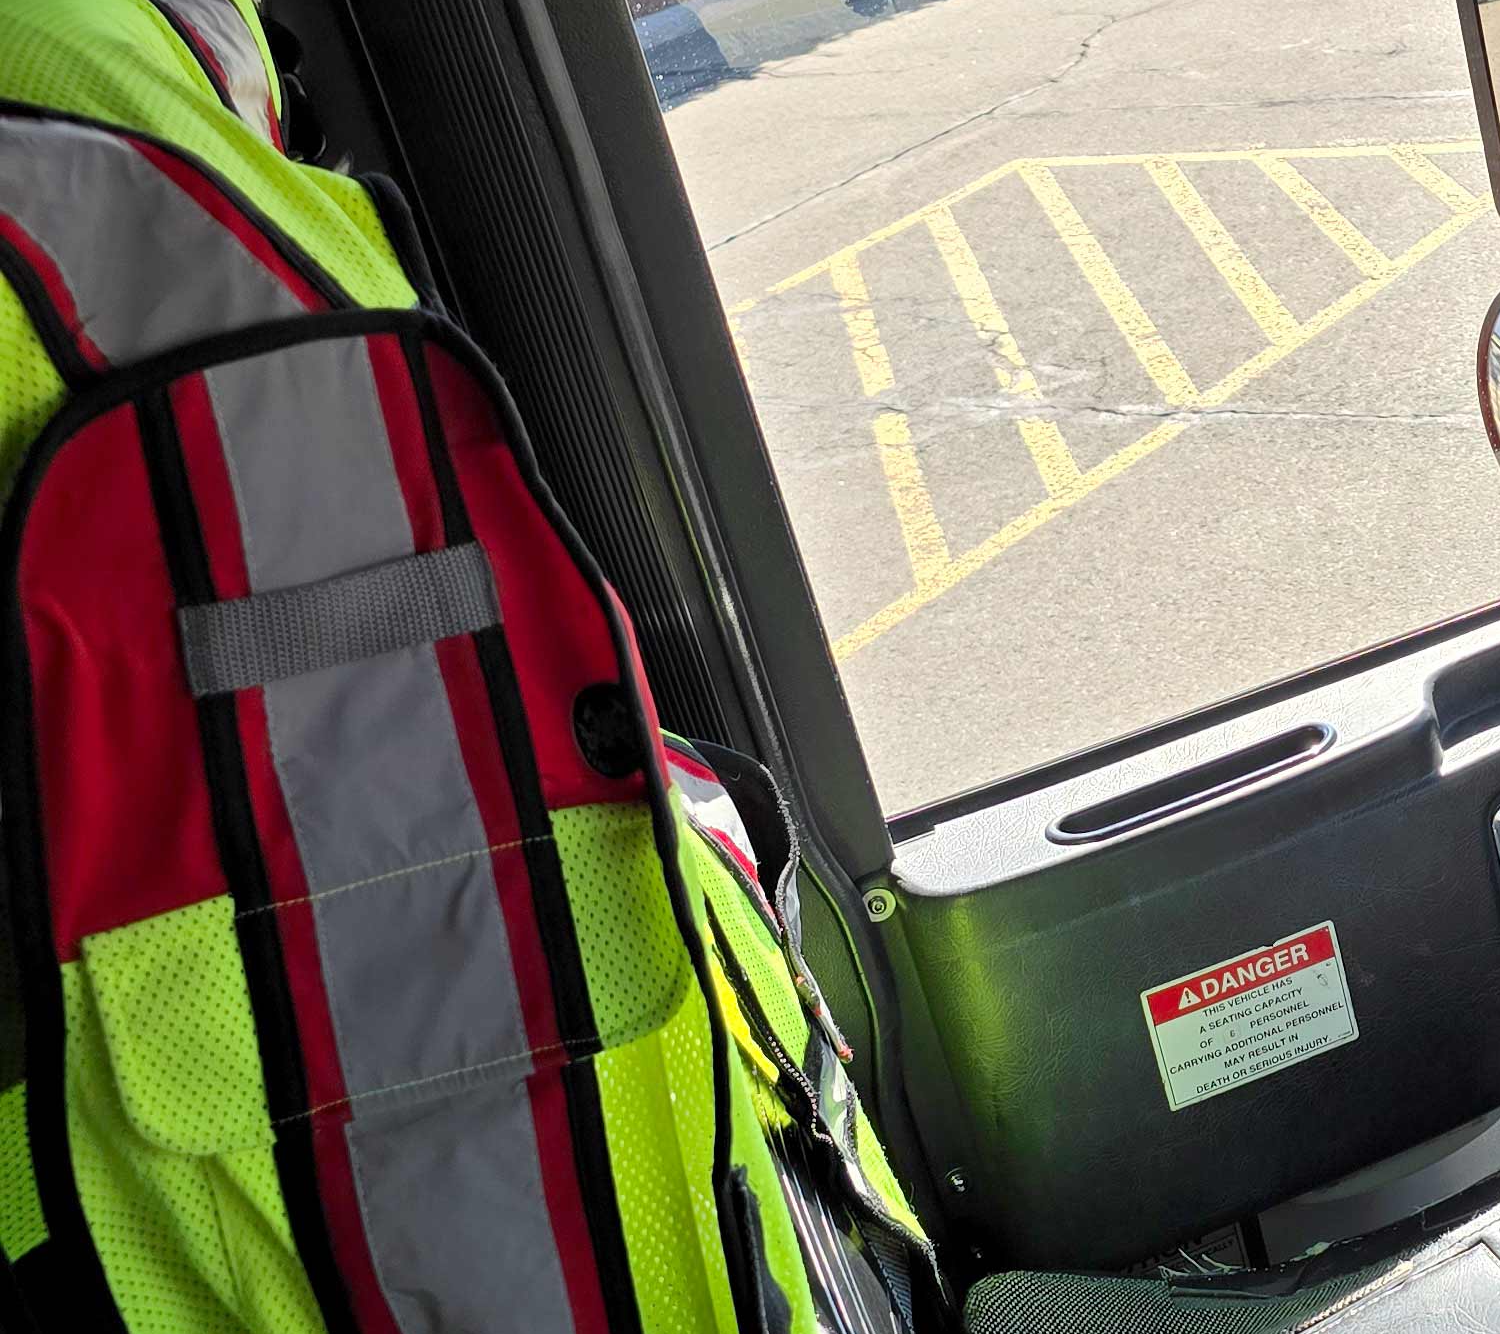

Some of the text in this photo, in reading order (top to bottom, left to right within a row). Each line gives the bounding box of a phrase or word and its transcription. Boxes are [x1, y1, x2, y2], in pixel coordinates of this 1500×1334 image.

[1201, 943, 1309, 1000] DANGER
[1199, 987, 1303, 1035] A SEATING CAPACITY
[1203, 977, 1293, 1018] THIS VEHICLE HAS
[1170, 1000, 1345, 1075] CARRYING ADDITIONAL PERSONNEL
[1199, 1037, 1214, 1049] OF
[1249, 1000, 1309, 1029] PERSONNEL
[1196, 1075, 1230, 1094] DEATH
[1233, 1066, 1248, 1080] OR
[1250, 1049, 1293, 1074] SERIOUS
[1224, 1032, 1299, 1070] MAY RESULT IN
